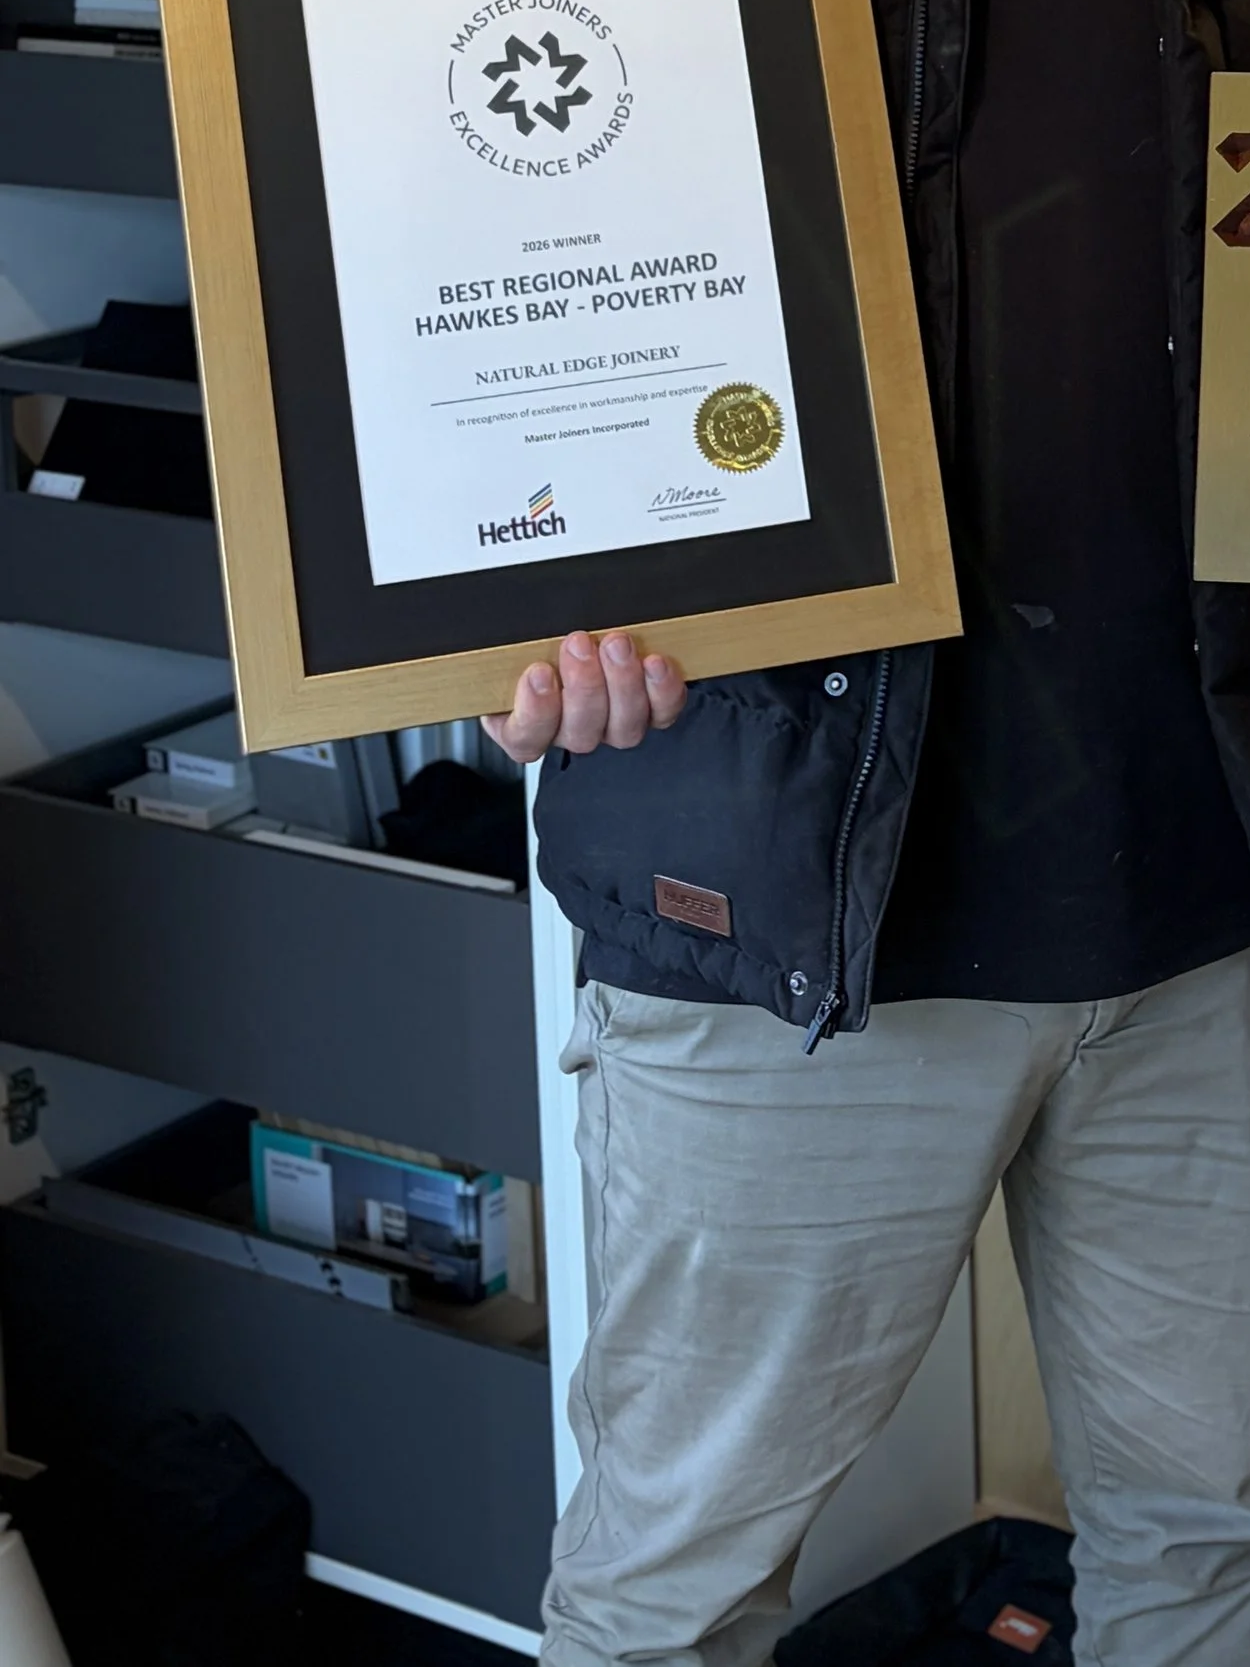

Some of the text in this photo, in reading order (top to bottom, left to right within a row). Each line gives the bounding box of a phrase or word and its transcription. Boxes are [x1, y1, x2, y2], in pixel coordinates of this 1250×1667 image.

[449, 92, 634, 177] EXCELLENCE AWARDS
[521, 233, 602, 252] 2026 WINNER
[438, 252, 718, 305] BEST REGIONAL AWARD
[415, 305, 519, 336] HAWKES
[525, 299, 570, 322] BAY
[591, 282, 697, 314] POVERTY
[704, 275, 746, 299] BAY
[475, 345, 681, 385] NATURAL EDGE JOINERY
[456, 384, 709, 427] In recognition of excellence in workmanship and expertise
[524, 418, 650, 444] Master Joiners Incorporated
[477, 510, 567, 546] Hettich
